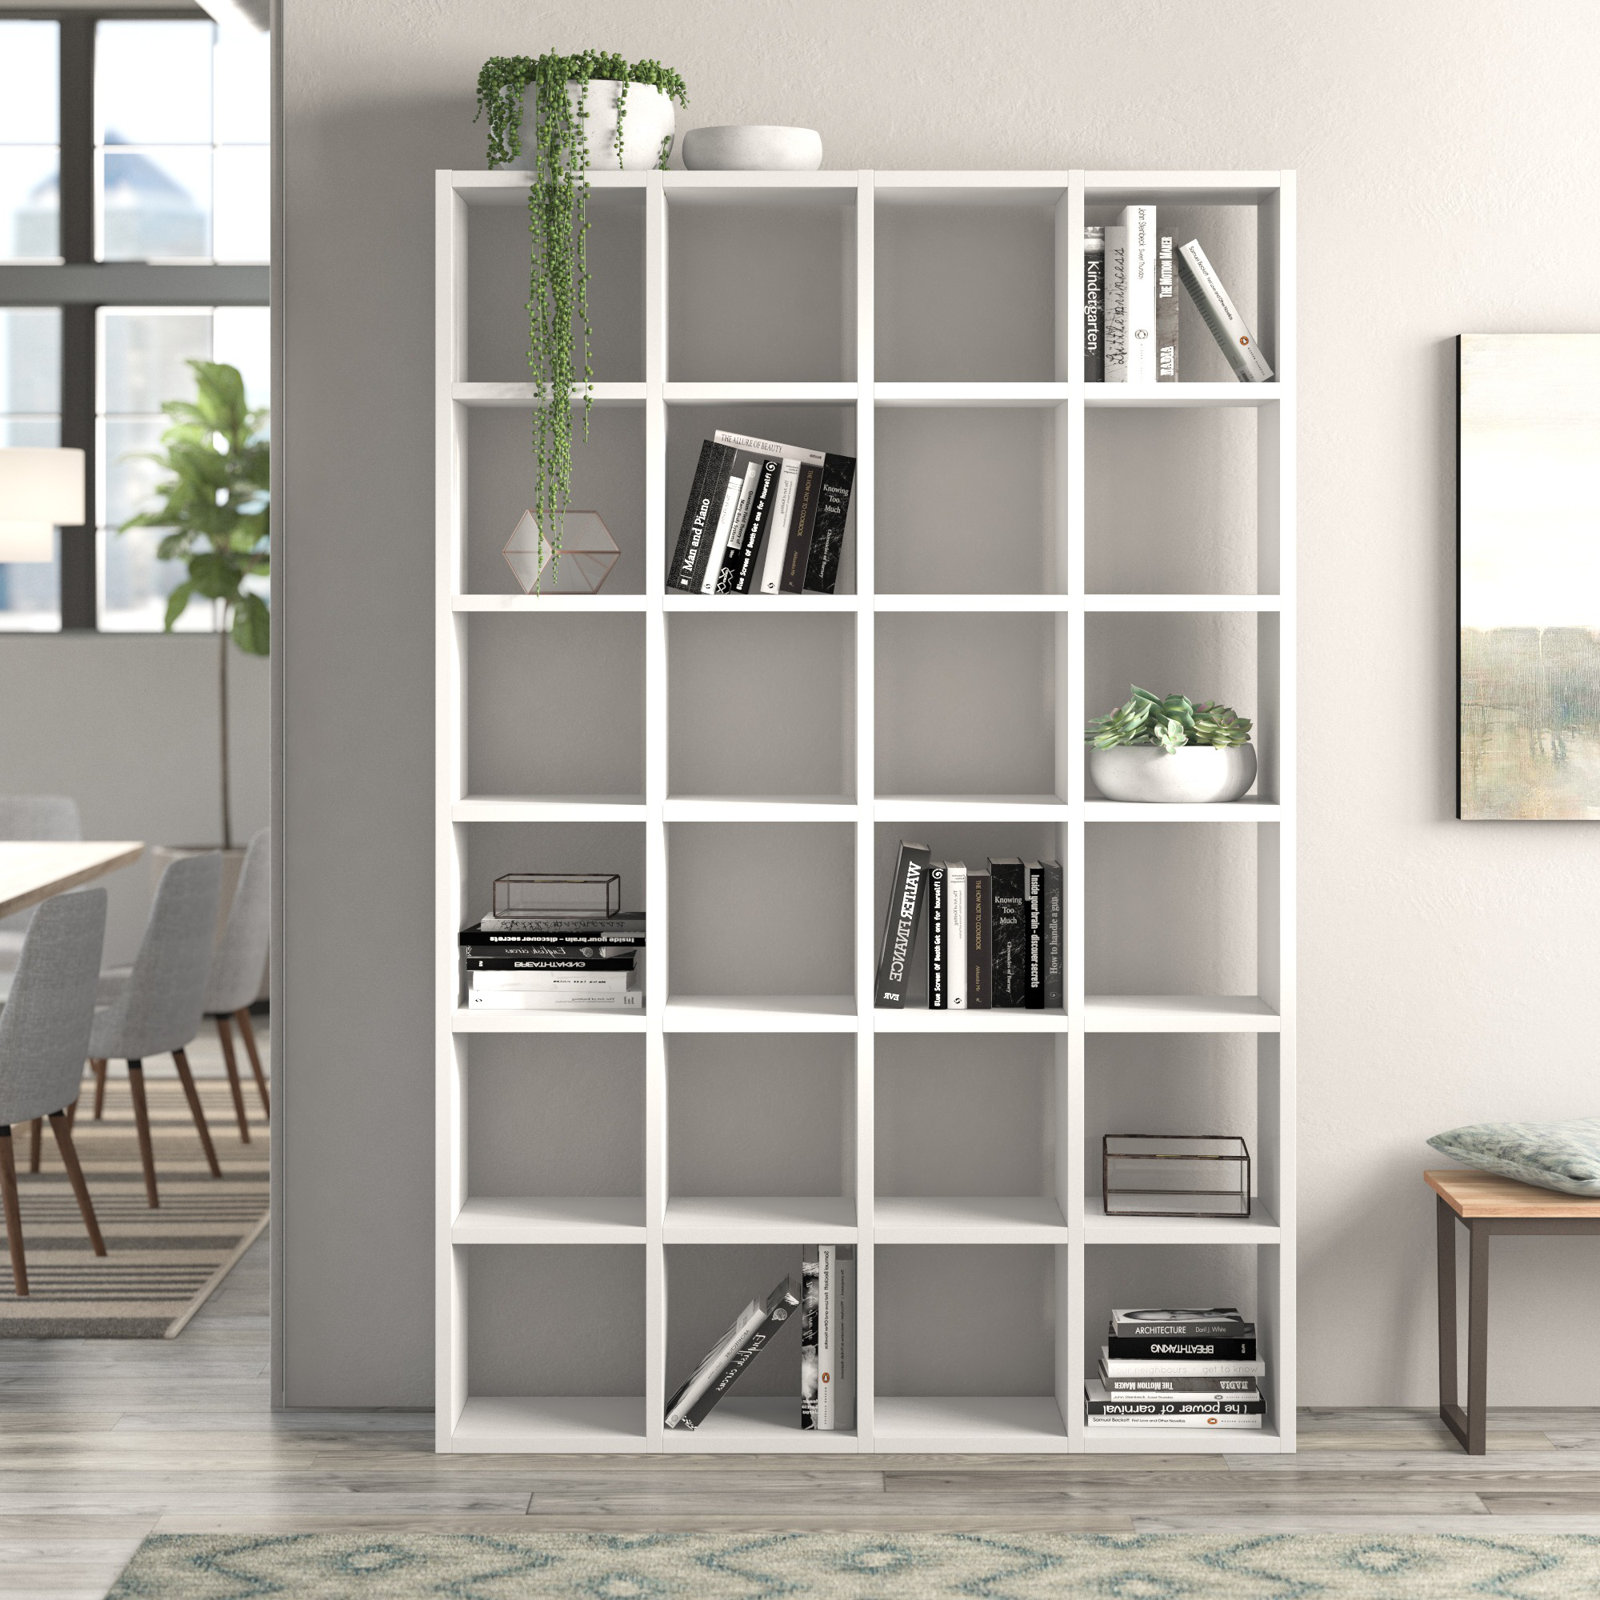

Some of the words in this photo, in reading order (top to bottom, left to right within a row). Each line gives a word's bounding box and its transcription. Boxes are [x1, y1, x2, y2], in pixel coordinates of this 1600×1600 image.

[1084, 260, 1101, 350] Kindergarten
[823, 484, 850, 497] Knowing
[694, 498, 711, 526] Piano
[824, 505, 841, 514] Much
[690, 527, 703, 547] and
[682, 548, 698, 571] Man
[1030, 874, 1040, 895] Inside
[994, 895, 1023, 905] Knowing
[1028, 895, 1039, 912] your
[999, 916, 1018, 925] Much
[1030, 911, 1040, 930] brain
[1049, 919, 1058, 945] handle
[587, 935, 608, 943] your
[1030, 934, 1040, 963] discover
[1050, 946, 1058, 955] to
[1050, 956, 1058, 974] How
[1030, 963, 1040, 988] secrets
[1135, 1325, 1187, 1335] ARCHITECTURE
[1150, 1344, 1214, 1354] BREATHTAKING
[1114, 1381, 1136, 1390] MAKER
[1136, 1381, 1161, 1390] MOTION
[1161, 1381, 1174, 1390] THE
[1103, 1404, 1156, 1415] carnival
[1160, 1404, 1175, 1415] of
[1179, 1401, 1221, 1414] power
